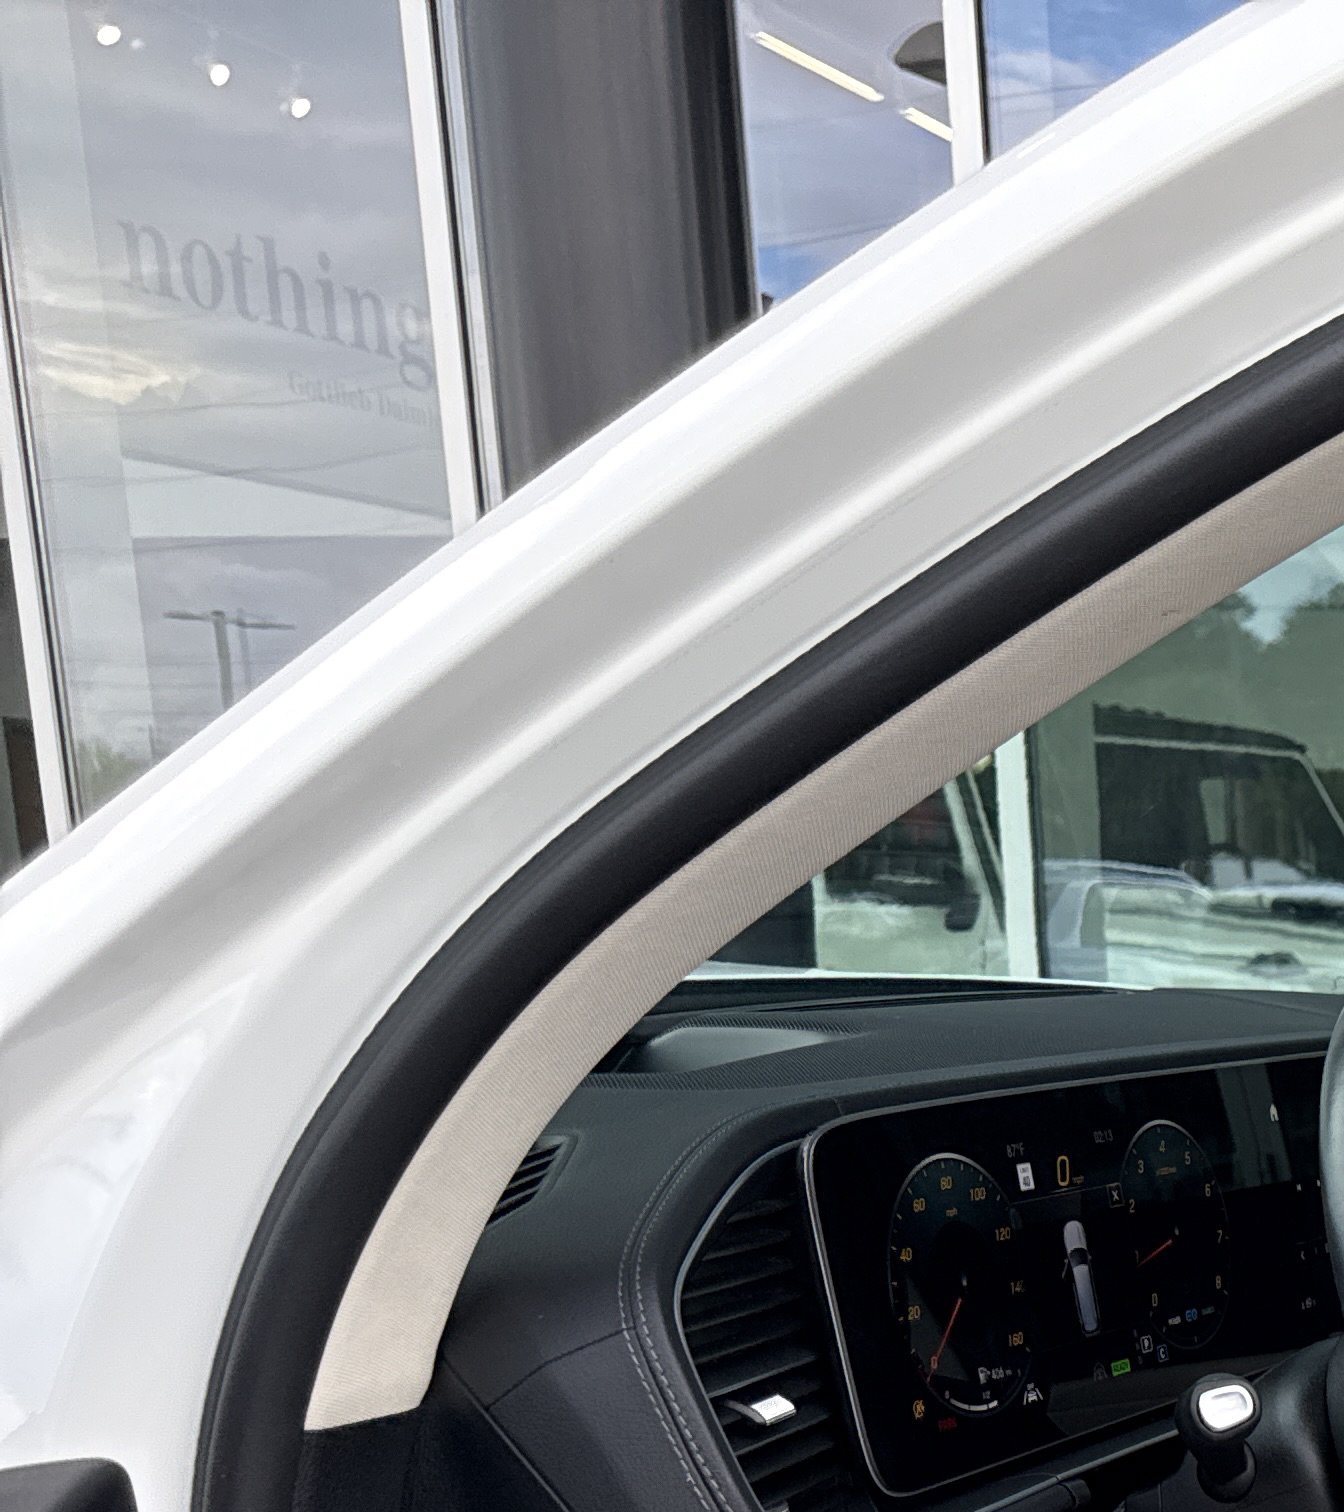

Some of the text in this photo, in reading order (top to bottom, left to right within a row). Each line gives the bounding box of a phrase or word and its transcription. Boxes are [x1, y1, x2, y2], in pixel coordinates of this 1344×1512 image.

[116, 218, 436, 392] nothing
[1158, 1139, 1166, 1153] 4
[1184, 1151, 1192, 1165] 5
[1056, 1155, 1071, 1187] 0
[1136, 1159, 1145, 1174] 3
[940, 1176, 953, 1190] 80
[1204, 1183, 1212, 1198] 6
[969, 1187, 987, 1201] 100
[912, 1198, 926, 1213] 60
[1128, 1198, 1136, 1213] 2
[994, 1226, 1011, 1242] 120
[1216, 1229, 1223, 1244] 7
[900, 1248, 913, 1262] 40
[907, 1305, 921, 1320] 20
